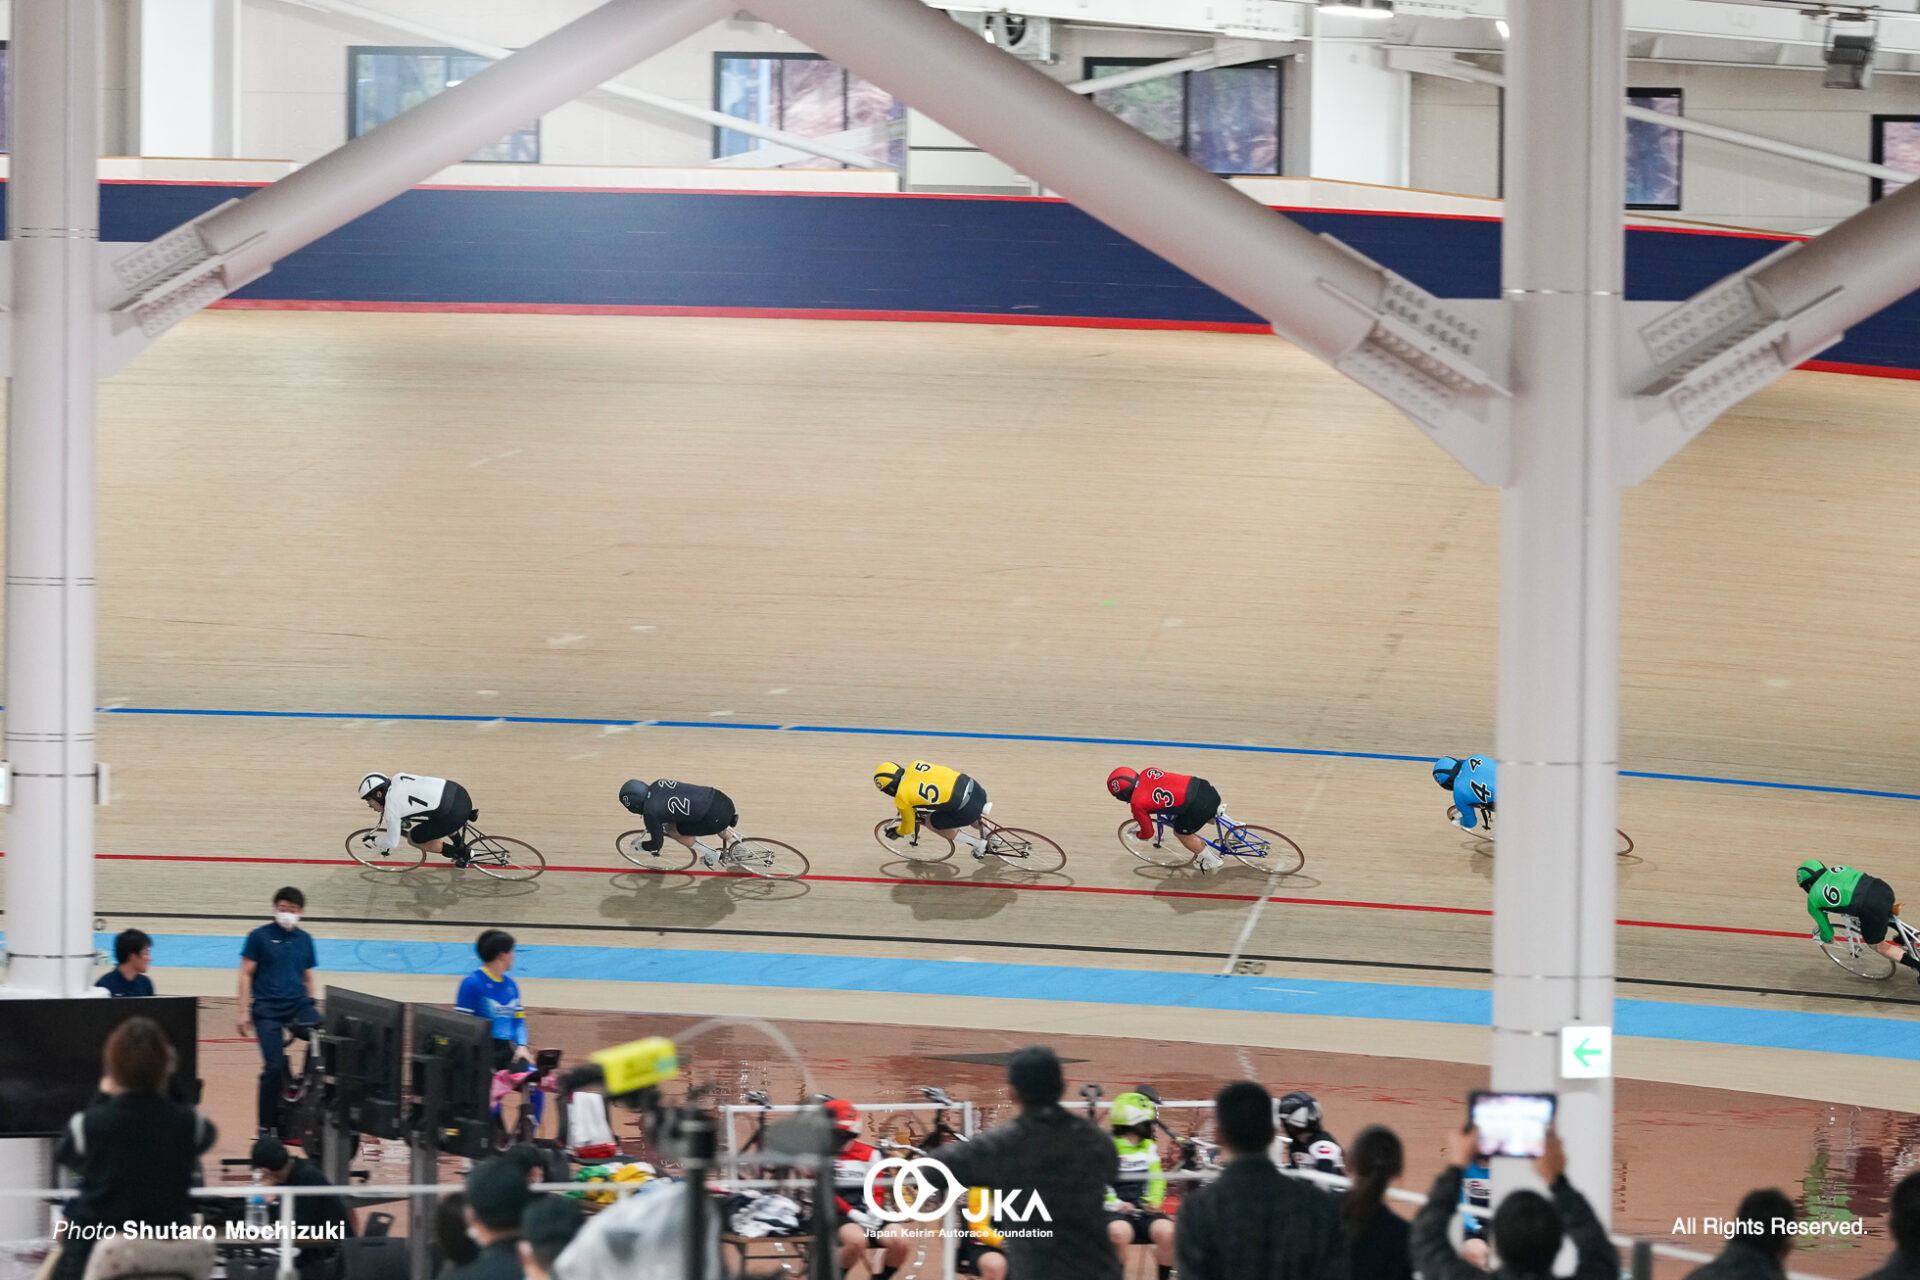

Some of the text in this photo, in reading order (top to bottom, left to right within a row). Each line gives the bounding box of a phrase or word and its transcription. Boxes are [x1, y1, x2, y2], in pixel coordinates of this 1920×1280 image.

[914, 762, 931, 773] 5
[1469, 757, 1482, 772] 4
[1146, 768, 1164, 780] 3
[918, 782, 940, 804] 5
[1111, 779, 1120, 792] 3
[1470, 779, 1491, 803] 4
[408, 795, 428, 807] 1
[1152, 786, 1175, 808] 3
[667, 796, 691, 816] 2
[1822, 883, 1841, 906] 6
